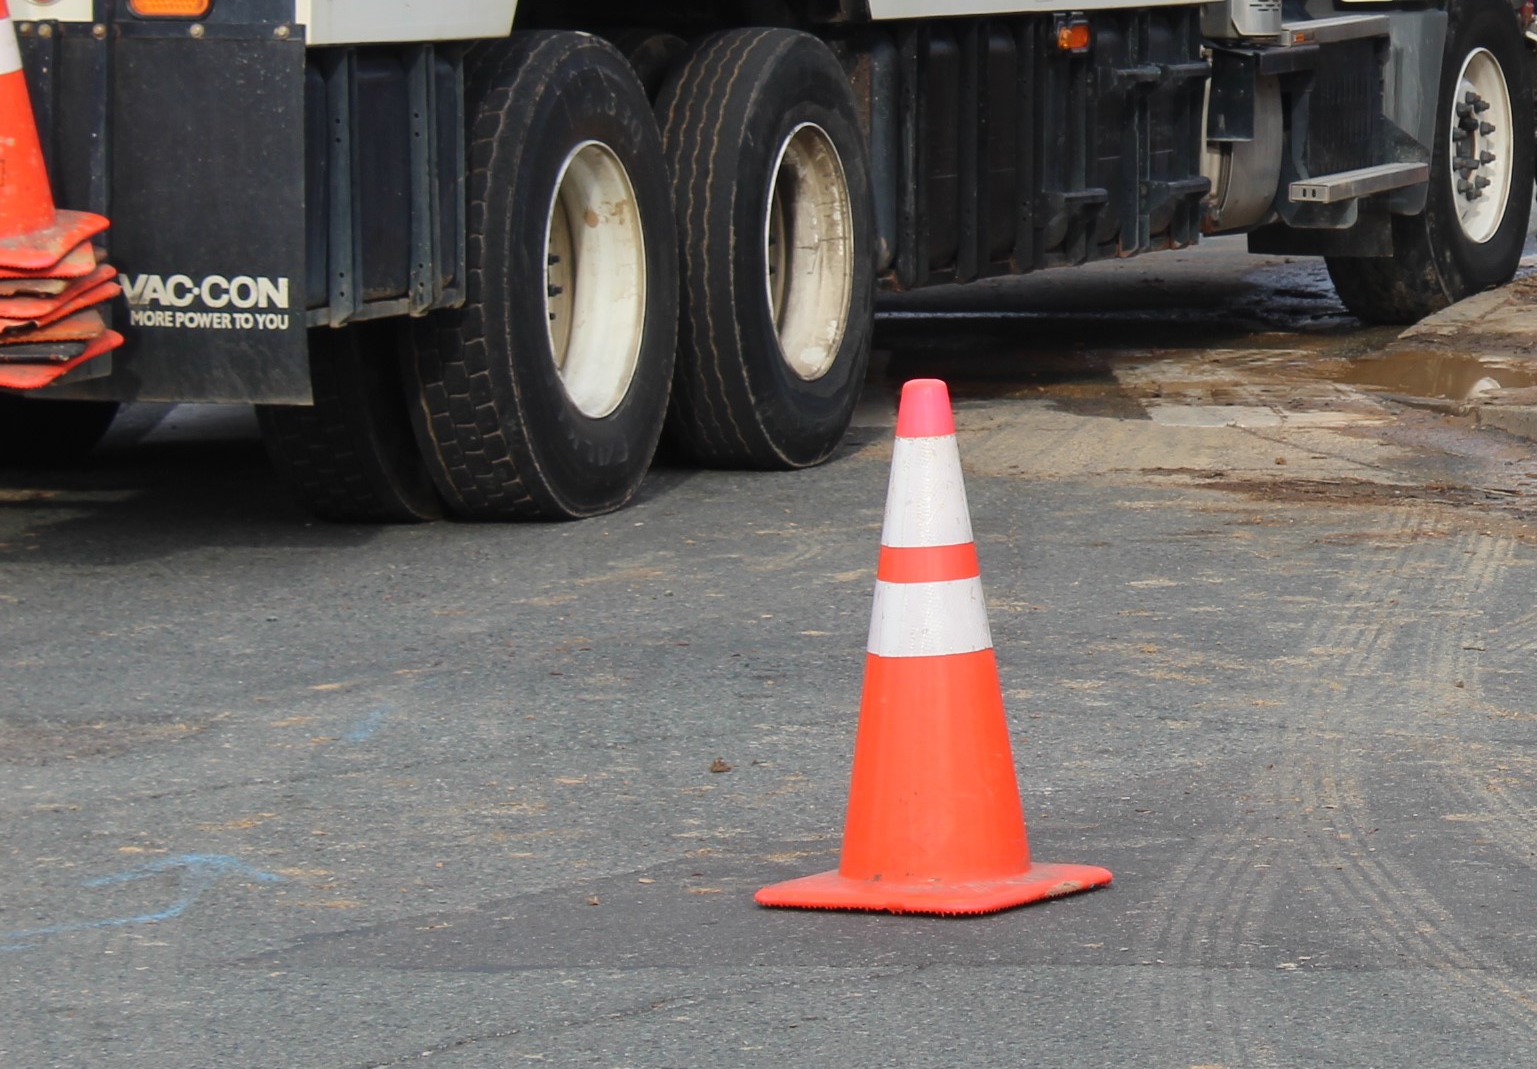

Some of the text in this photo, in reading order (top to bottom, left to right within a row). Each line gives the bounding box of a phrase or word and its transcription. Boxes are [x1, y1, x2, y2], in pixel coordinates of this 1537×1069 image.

[130, 310, 290, 330] MORE POWER TO YOU
